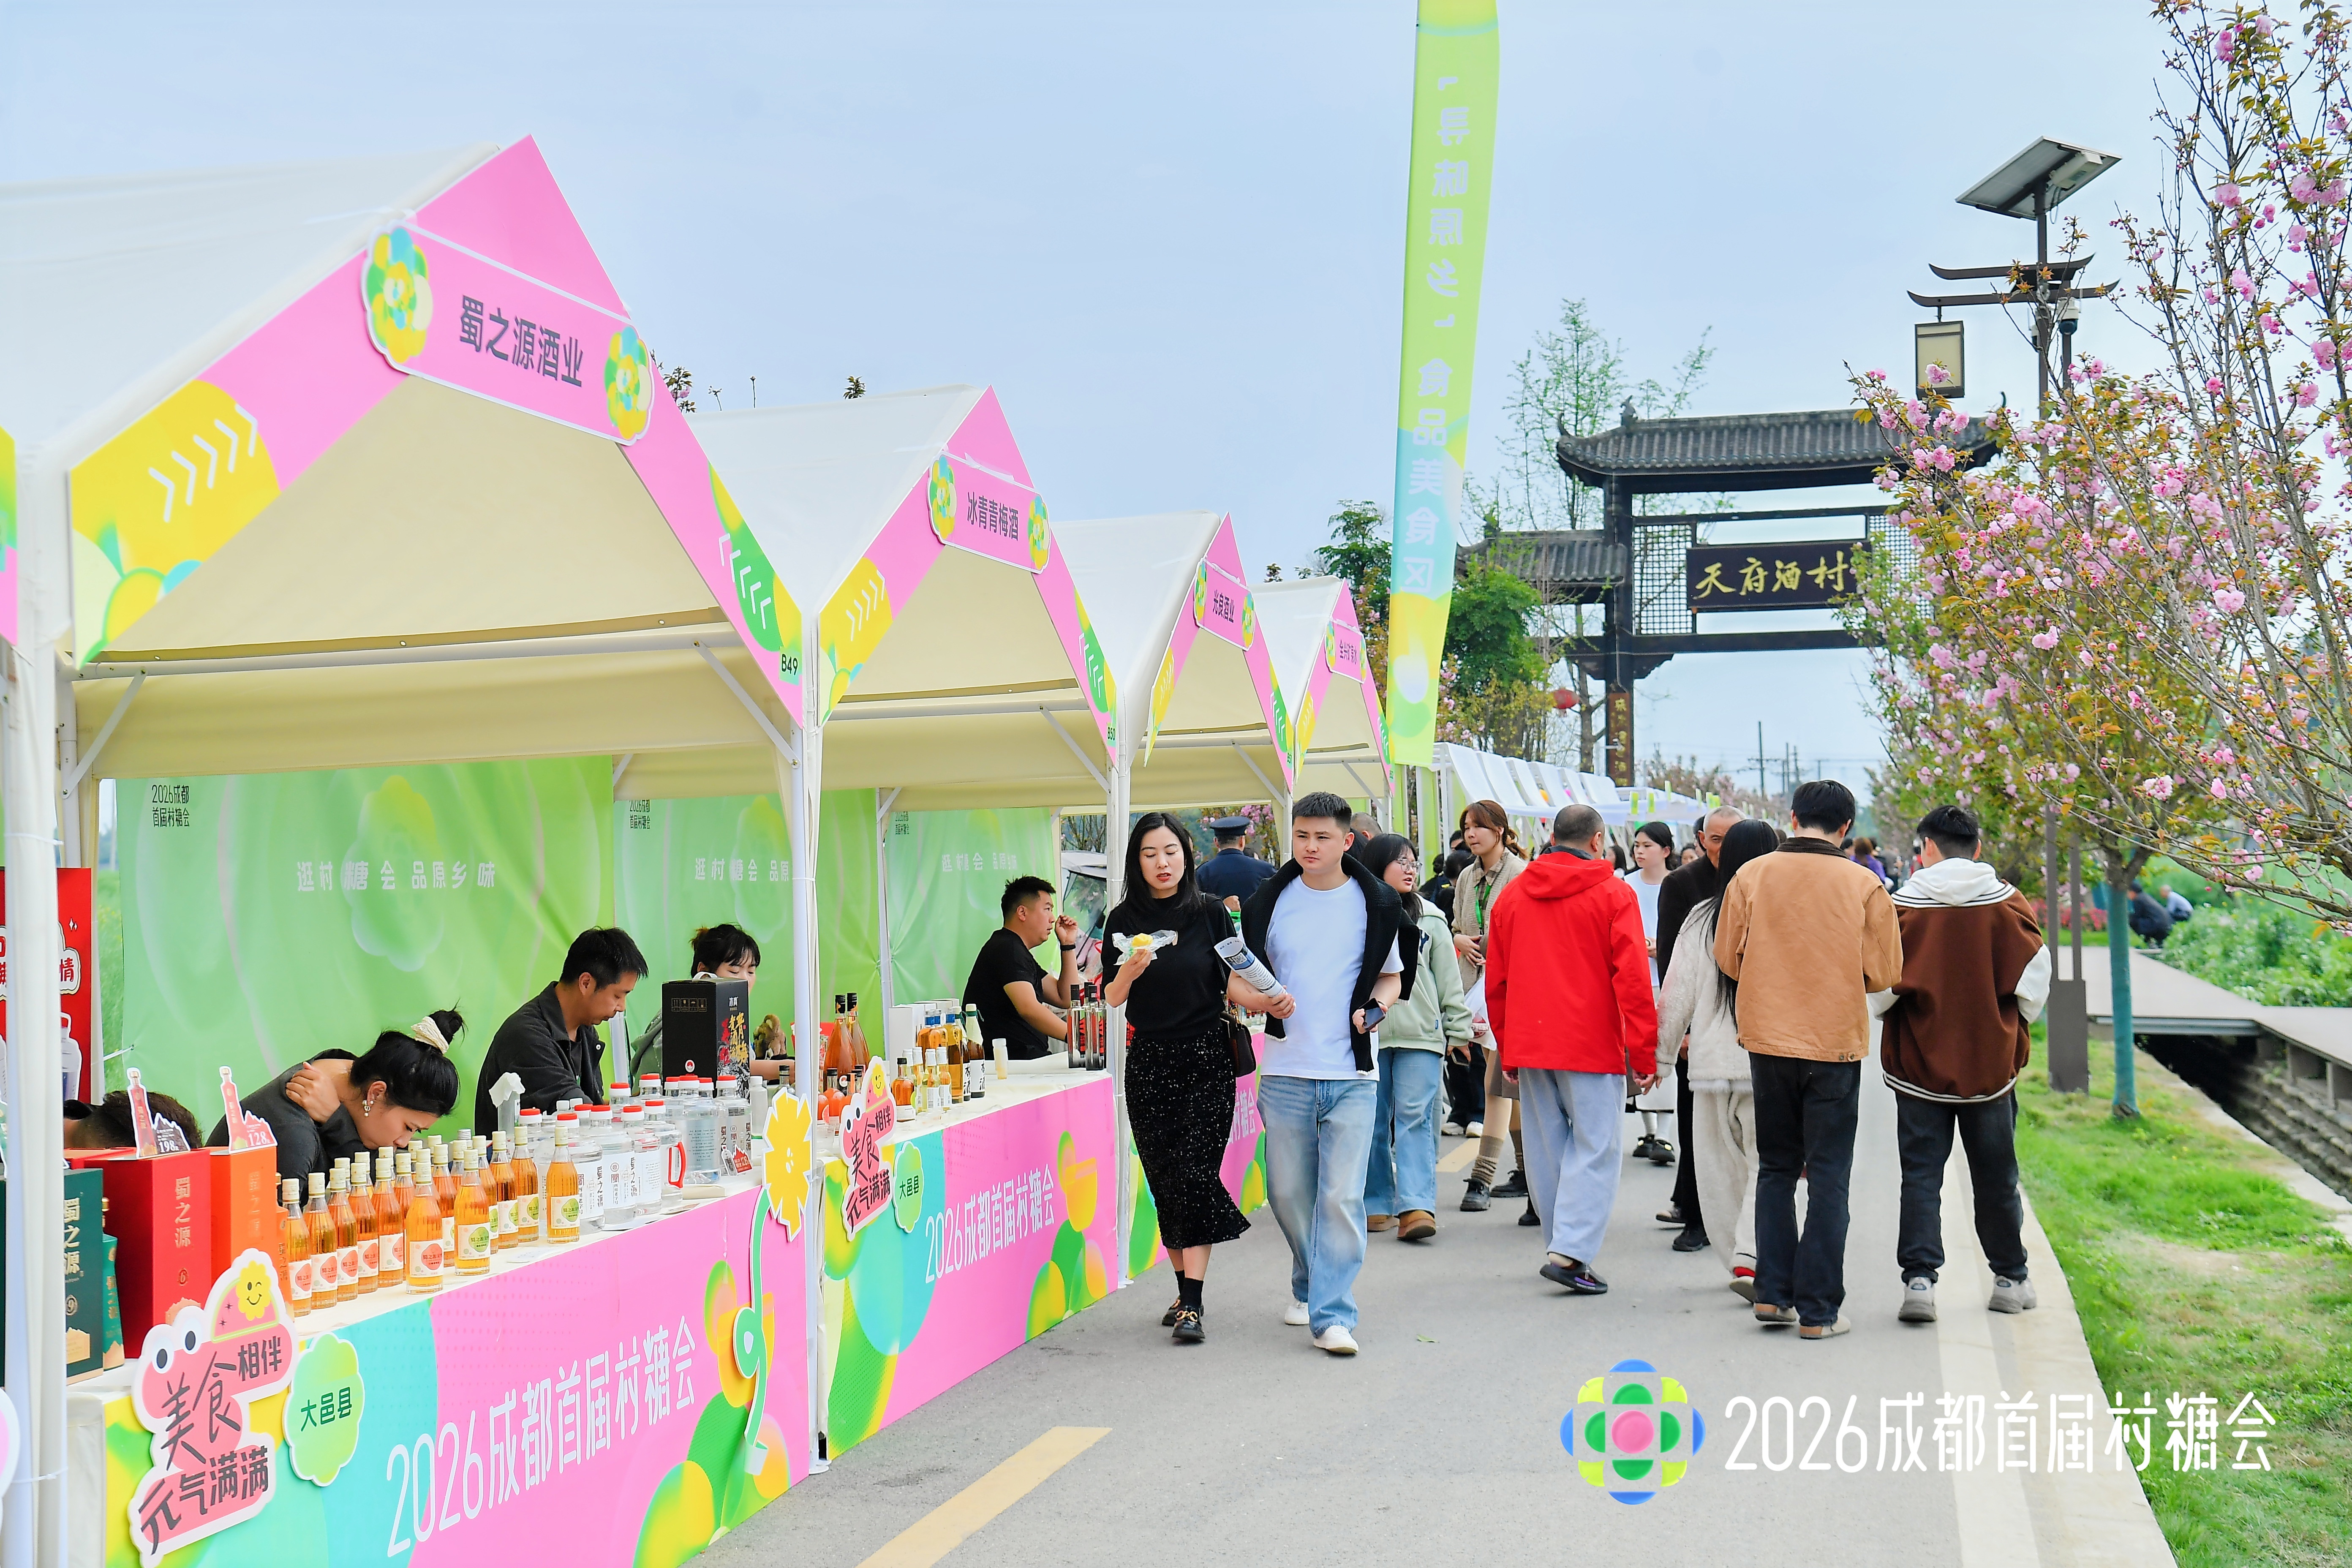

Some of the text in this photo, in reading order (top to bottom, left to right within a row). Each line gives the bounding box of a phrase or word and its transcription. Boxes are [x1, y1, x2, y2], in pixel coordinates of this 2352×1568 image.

[460, 294, 583, 387] 蜀之源酒业
[967, 491, 1018, 541] 冰青青梅酒
[1692, 550, 1849, 600] 天府酒村
[1212, 589, 1235, 623] 光良酒业
[781, 653, 798, 675] B49
[1108, 727, 1116, 741] B50
[152, 784, 190, 804] 2026成都
[152, 807, 190, 828] 首届村糖会
[174, 1176, 191, 1248] 蜀之源
[845, 1168, 890, 1234] 元气满满
[899, 1175, 920, 1200] 大邑县
[64, 1197, 80, 1275] 蜀之源
[925, 1163, 1055, 1284] 2026成都首届村糖会
[300, 1386, 353, 1432] 大邑县
[386, 1315, 697, 1558] 2026成都首届村糖会
[139, 1446, 270, 1557] 元气满满
